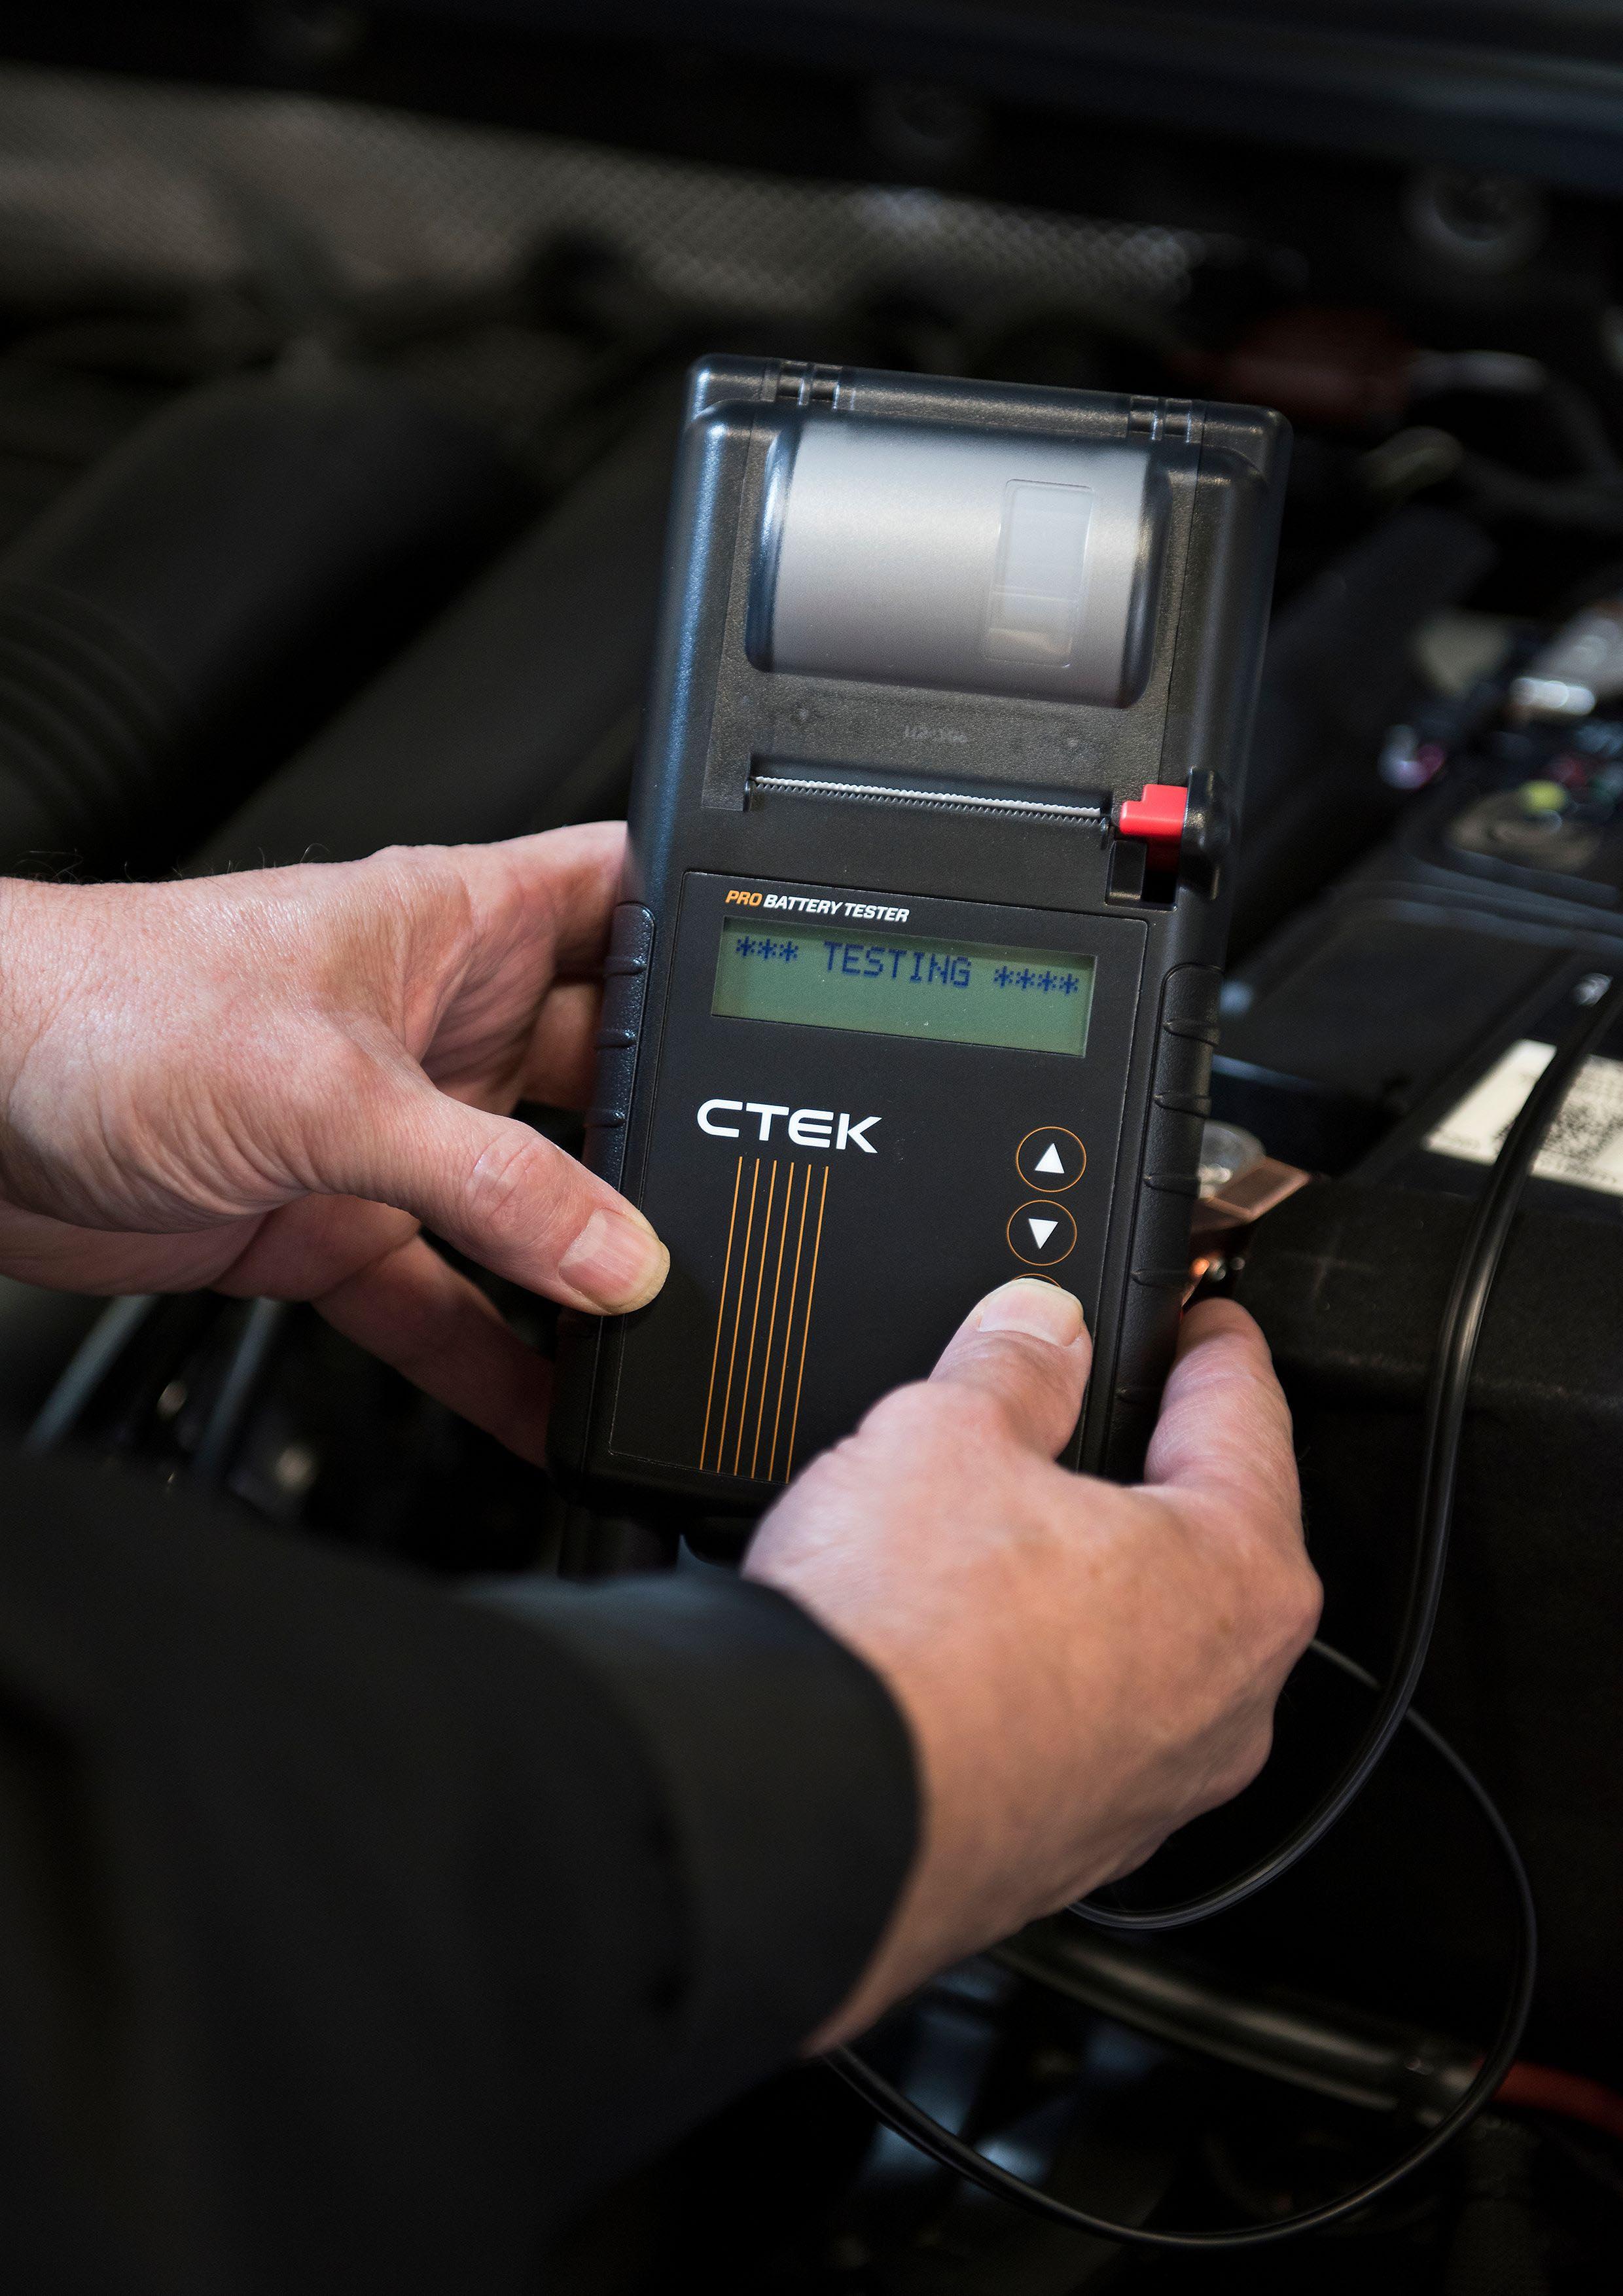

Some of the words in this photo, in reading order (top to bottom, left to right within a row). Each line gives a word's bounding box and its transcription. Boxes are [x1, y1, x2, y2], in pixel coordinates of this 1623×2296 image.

[724, 889, 762, 908] PRO
[762, 894, 844, 915] BATTERY
[844, 902, 910, 923] TESTER
[824, 941, 971, 989] TESTING
[697, 1098, 882, 1153] CTEK
